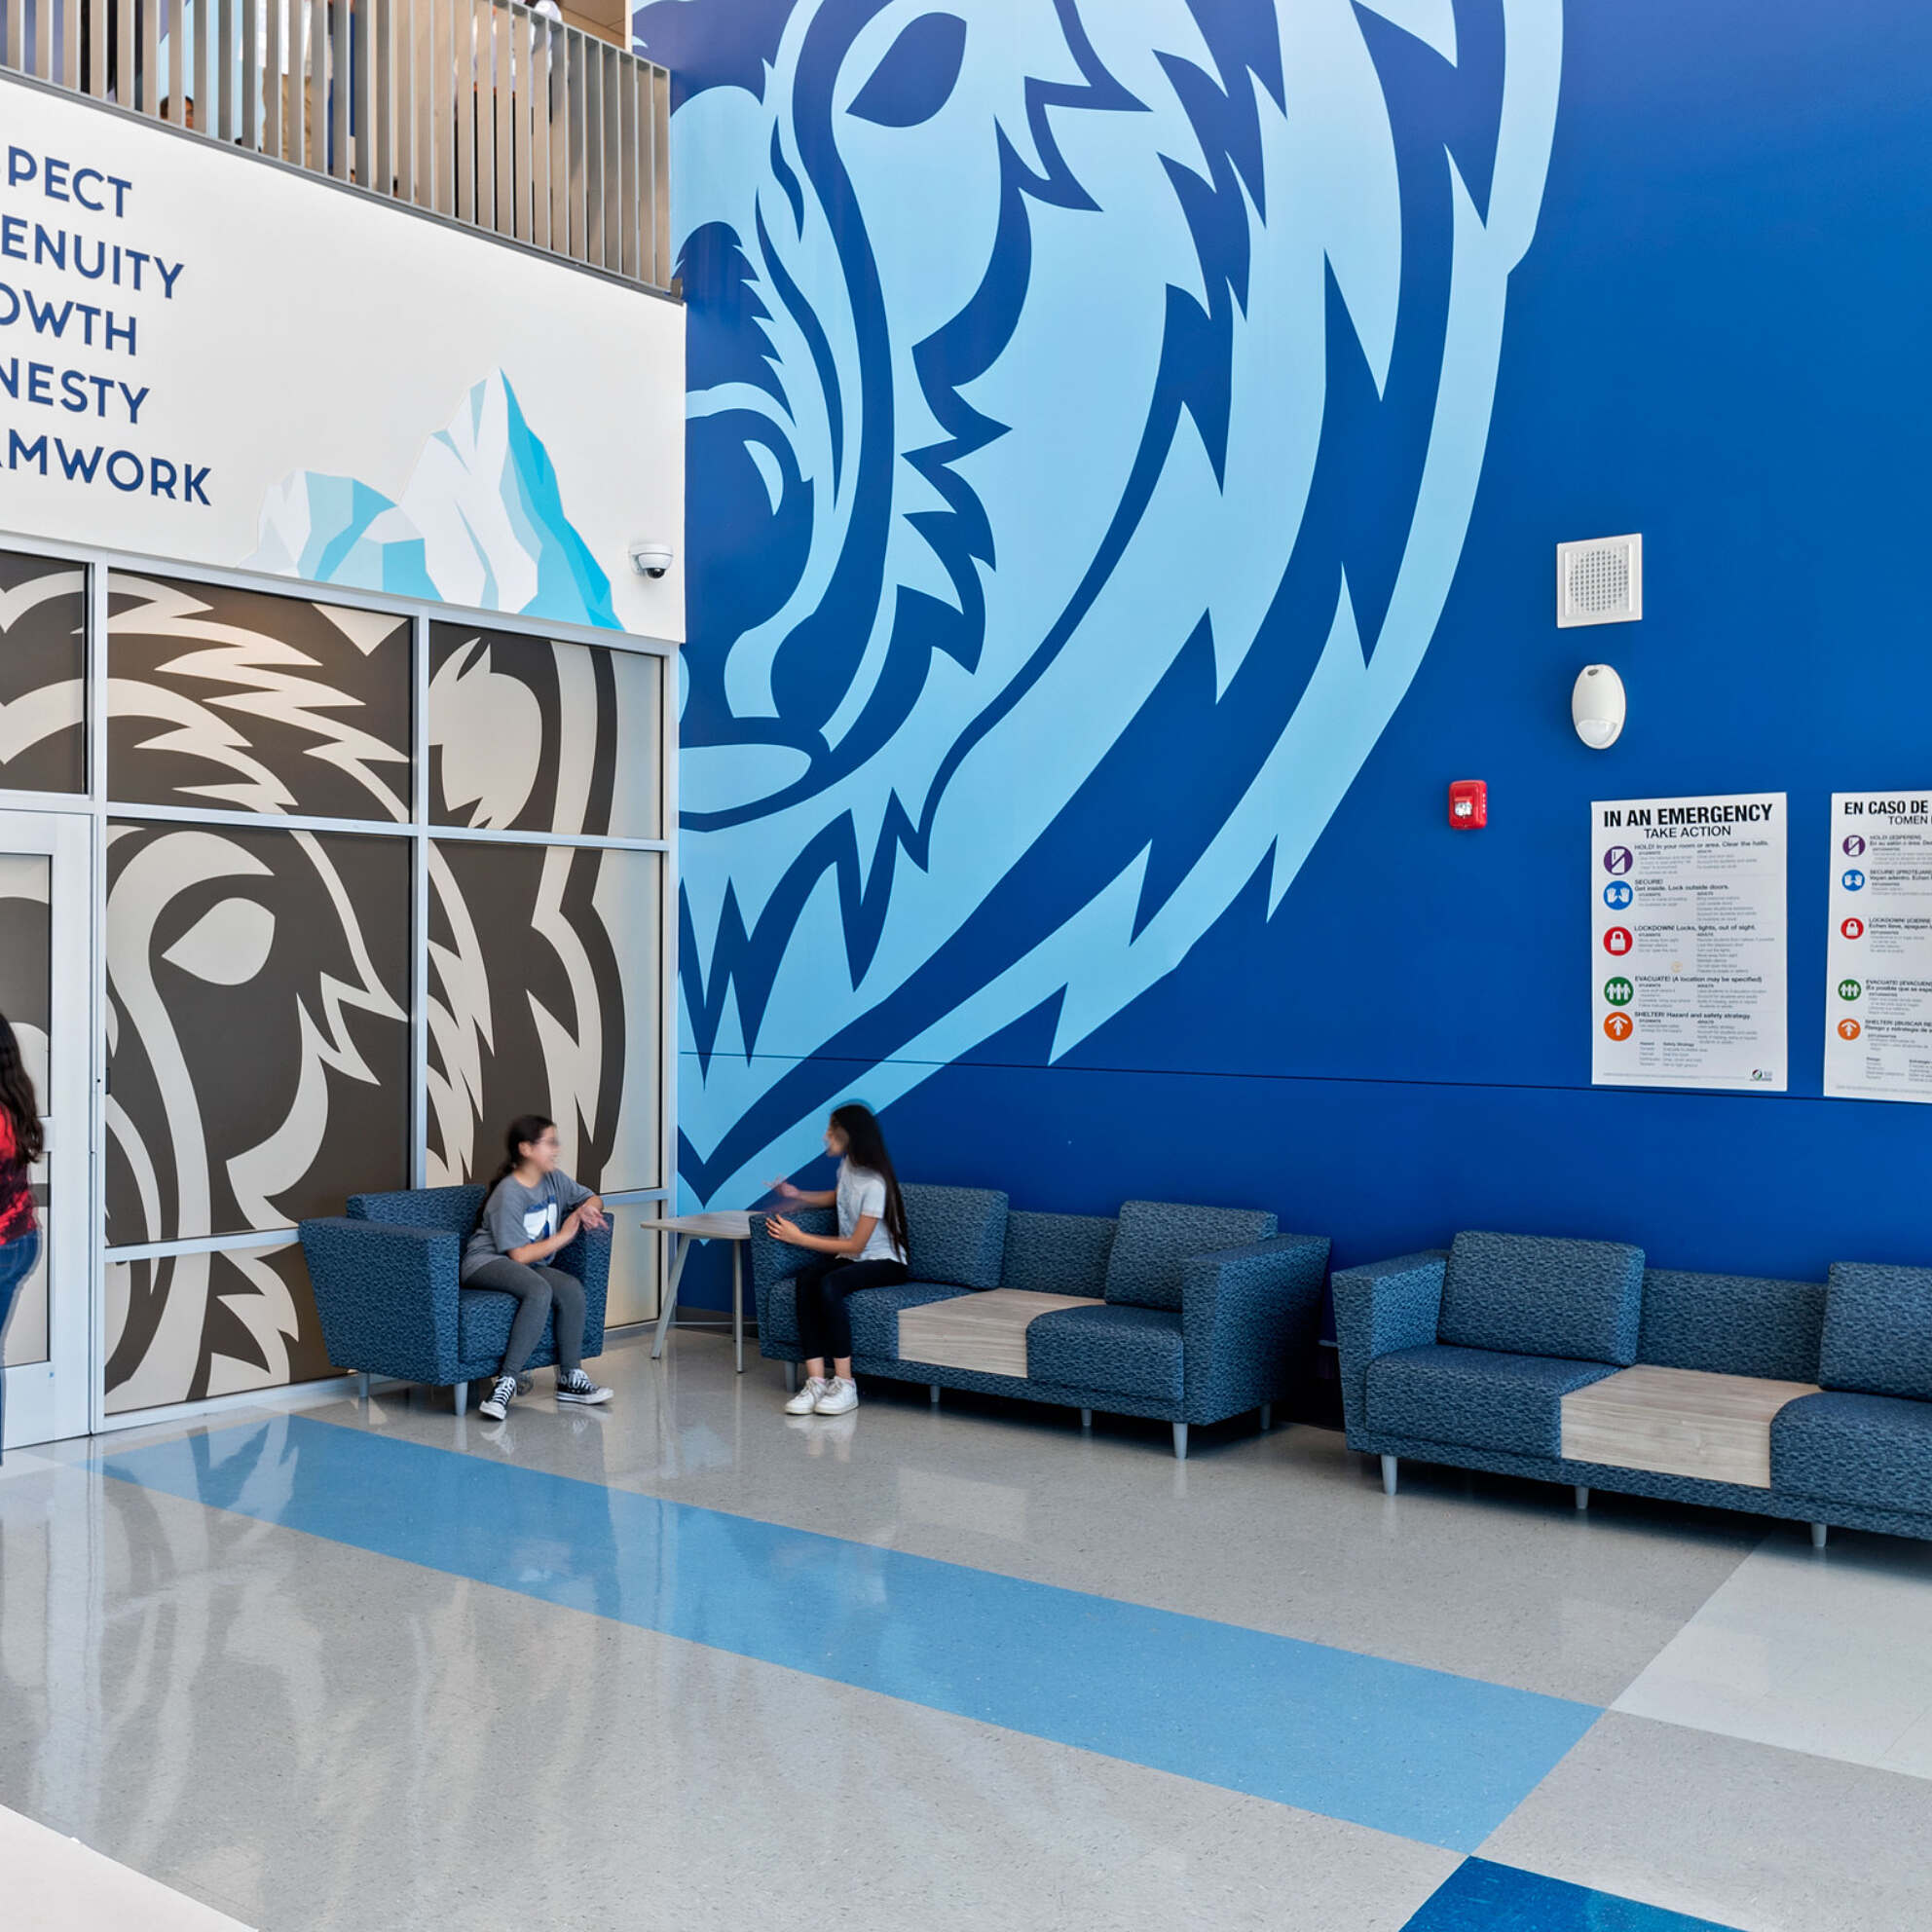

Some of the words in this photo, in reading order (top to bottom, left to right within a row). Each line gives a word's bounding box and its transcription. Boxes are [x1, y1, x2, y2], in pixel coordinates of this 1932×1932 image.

[2, 213, 185, 300] ENUITY
[0, 427, 212, 506] MWORK
[1604, 810, 1621, 828] IN
[1626, 809, 1652, 827] AN
[1657, 803, 1773, 826] EMERGENCY
[1844, 801, 1864, 815] EN
[1868, 800, 1907, 815] CASO
[1911, 799, 1928, 814] DE
[1887, 815, 1928, 826] TOMEN
[1644, 827, 1677, 838] TAKE
[1681, 826, 1731, 838] ACTION
